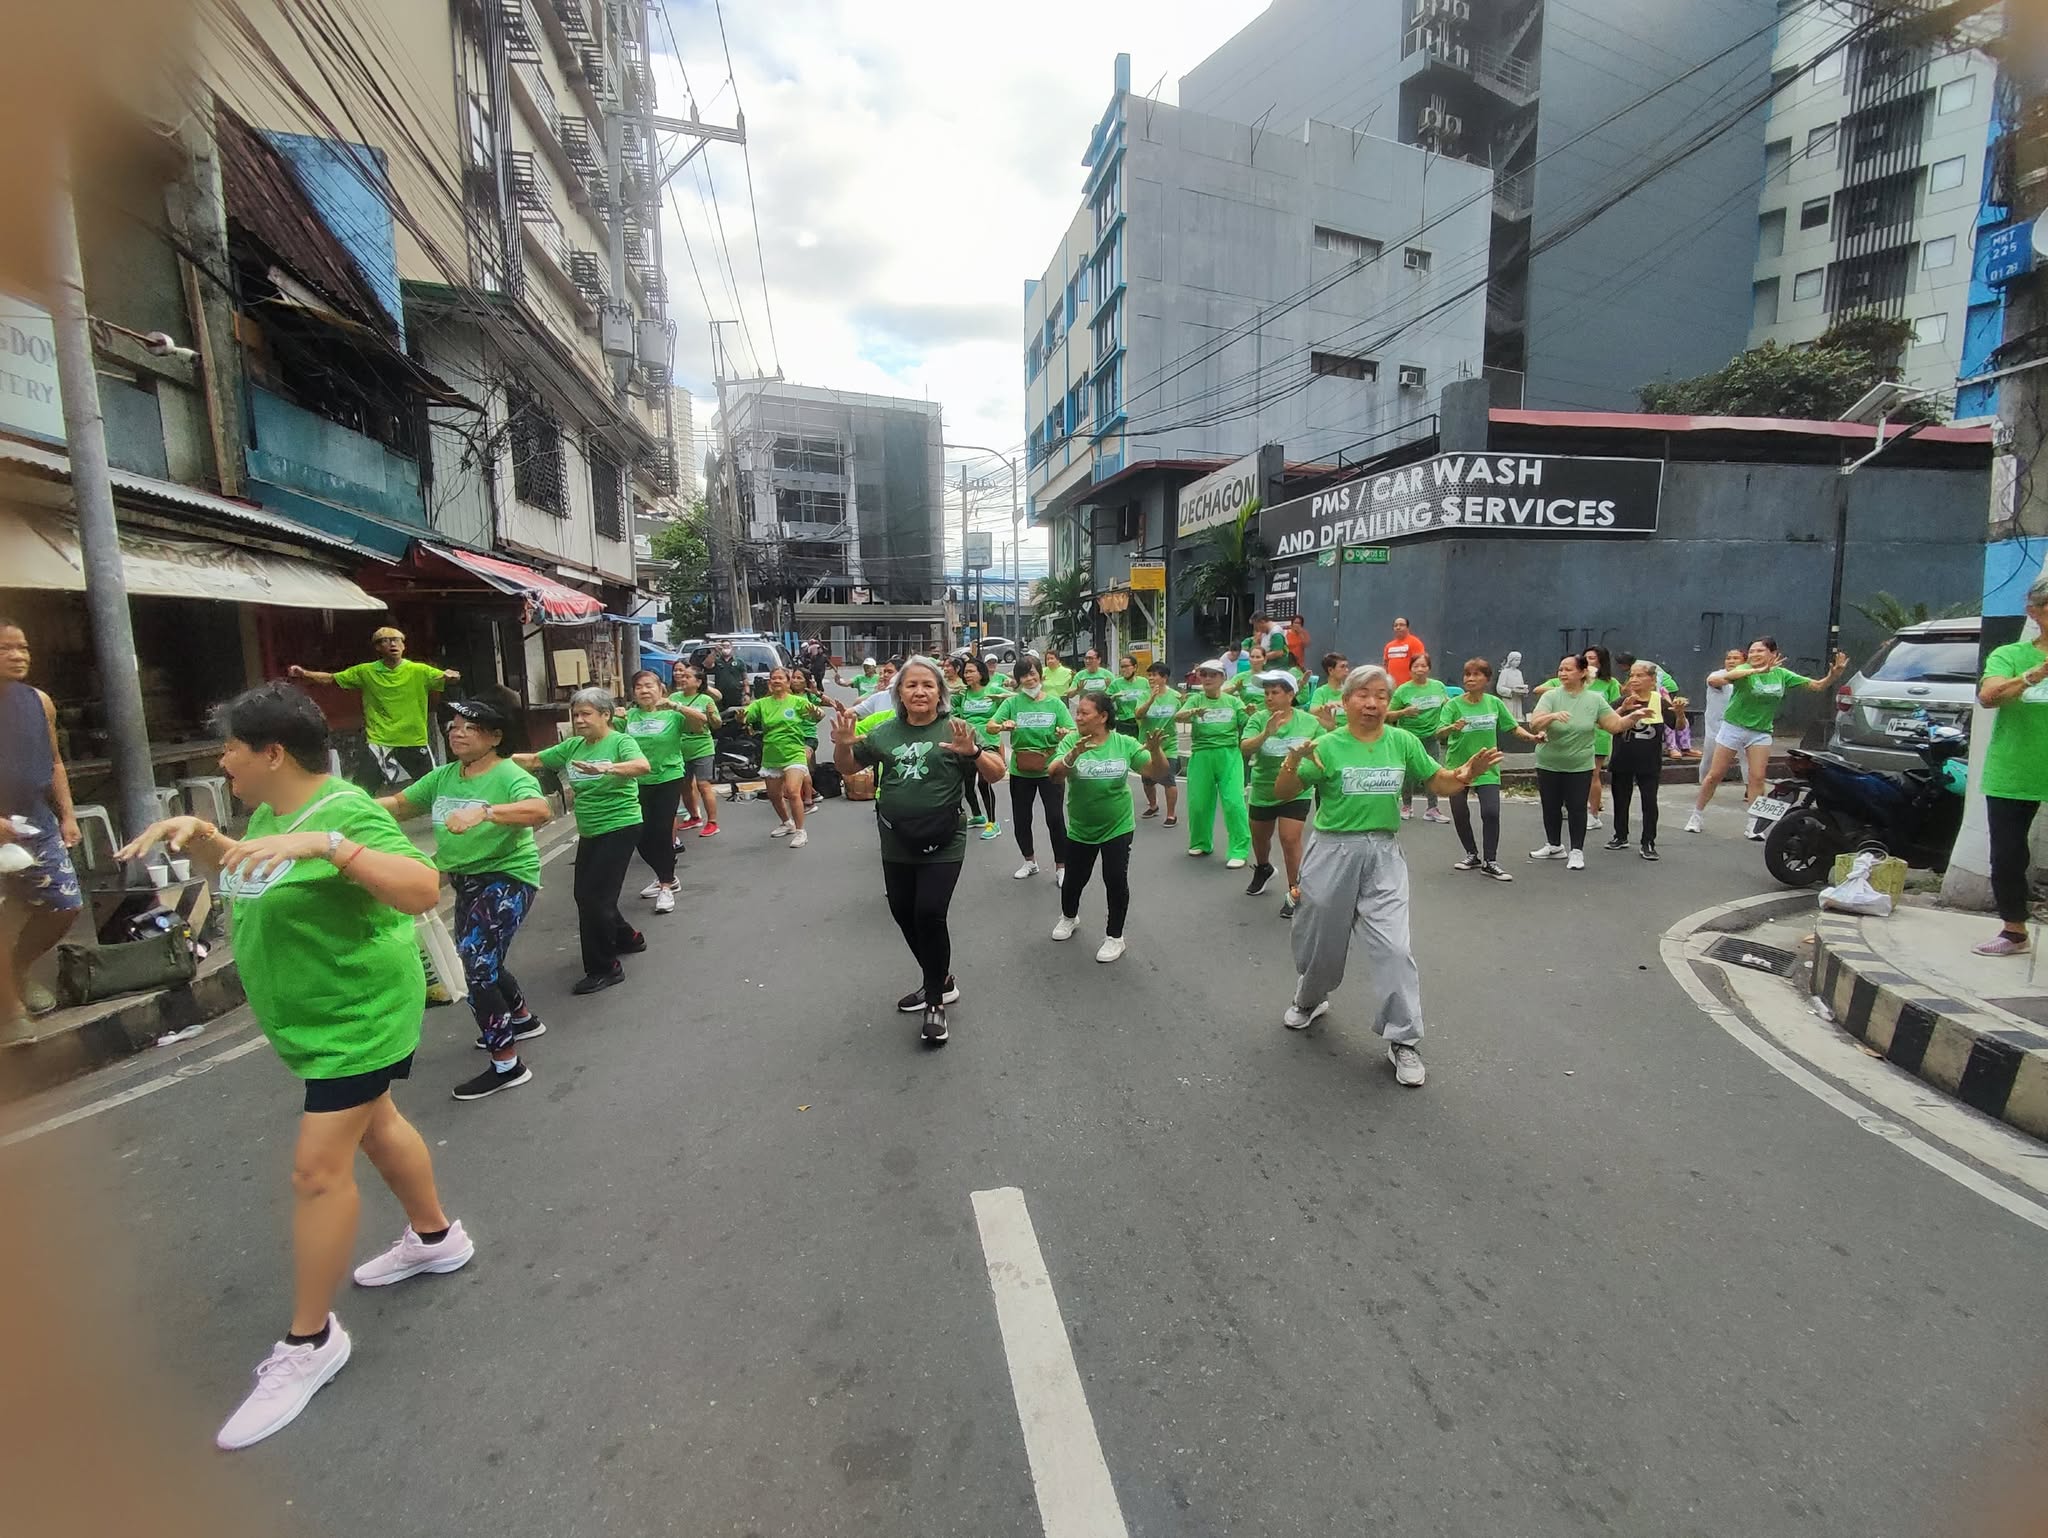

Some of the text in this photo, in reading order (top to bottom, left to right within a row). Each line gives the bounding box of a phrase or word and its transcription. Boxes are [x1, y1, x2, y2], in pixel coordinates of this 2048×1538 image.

[1992, 229, 2016, 247] MKT
[1992, 241, 2017, 260] 225
[1180, 473, 1255, 527] DECHAGON
[1312, 457, 1542, 518] PMS / CAR WASH
[1276, 496, 1615, 556] AND DETAILING SERVICES
